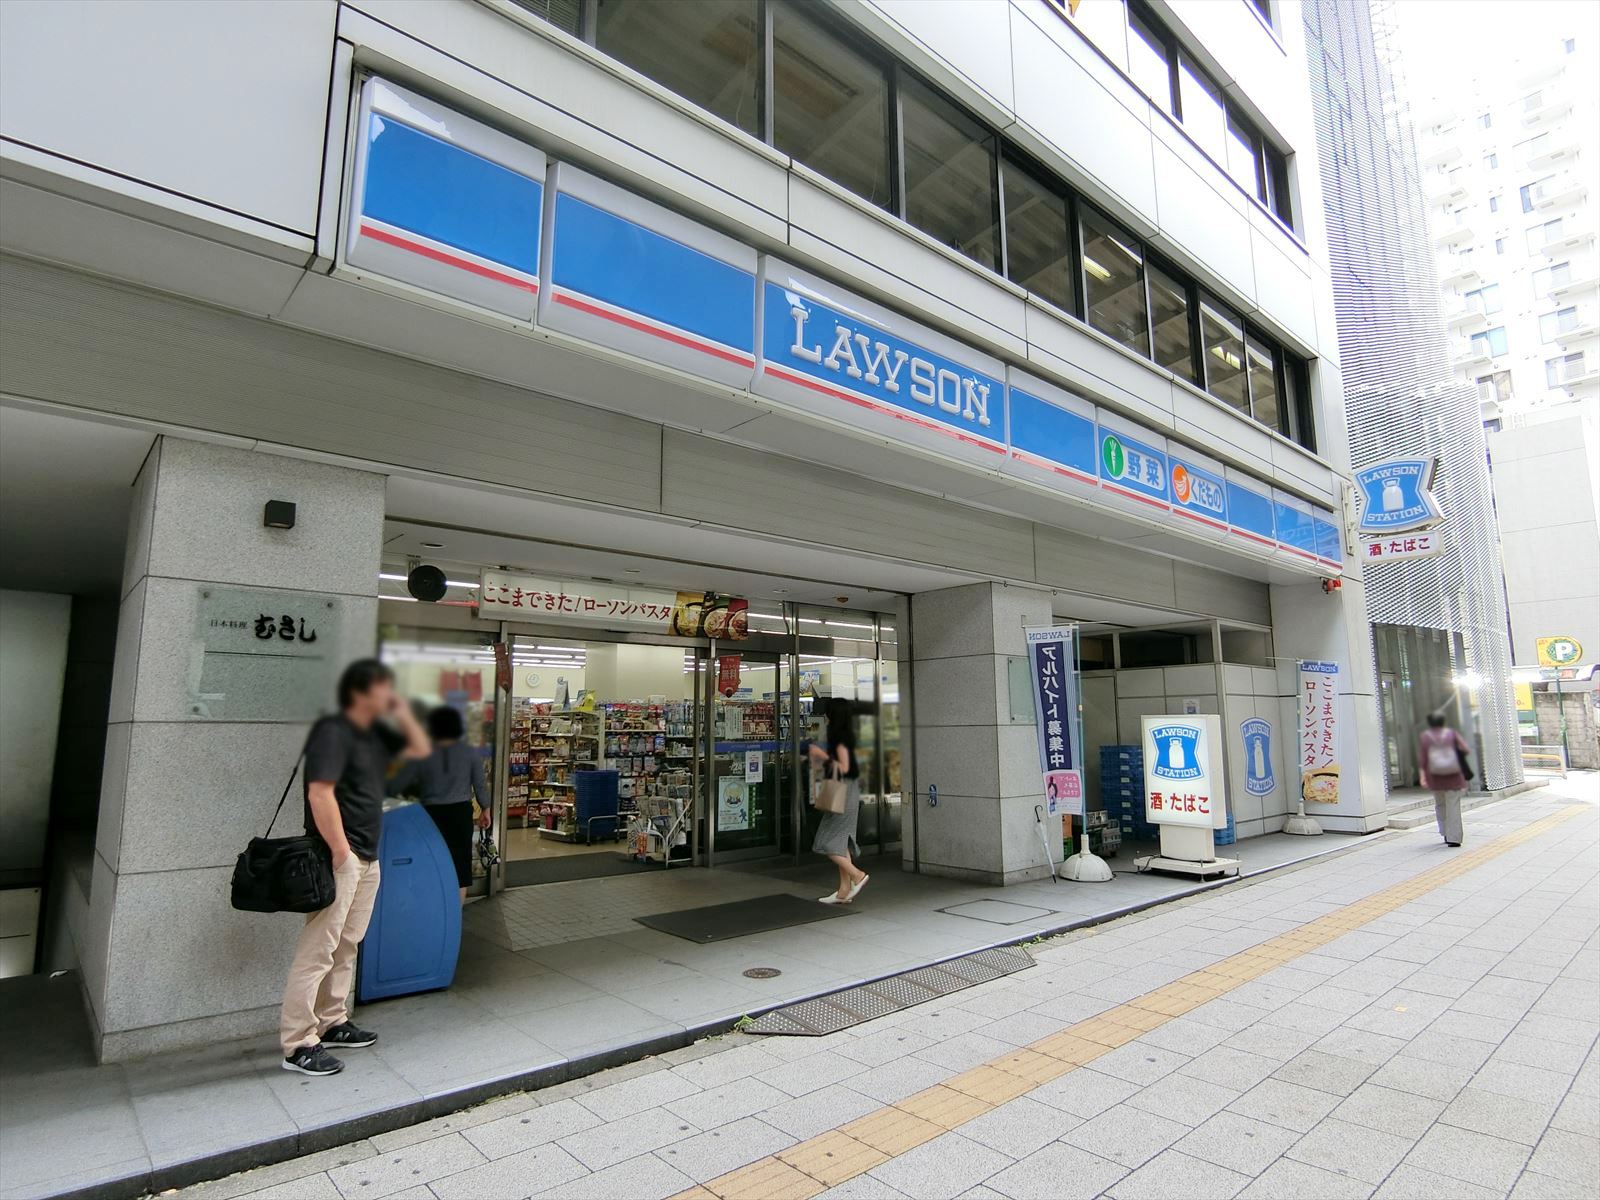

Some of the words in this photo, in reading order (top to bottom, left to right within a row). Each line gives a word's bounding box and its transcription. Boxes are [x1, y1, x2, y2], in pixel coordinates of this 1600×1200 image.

[790, 306, 991, 427] LAWSON
[1127, 449, 1160, 487] 野菜
[1362, 466, 1419, 484] LAWSON
[1190, 478, 1222, 511] くだもの
[1367, 505, 1425, 522] STATION
[1369, 538, 1430, 556] 酒・たばこ
[210, 619, 248, 630] 日本料理
[254, 613, 317, 642] むさし
[1554, 642, 1574, 661] P
[1302, 663, 1336, 673] LAWSON
[1243, 723, 1270, 738] LAWSON
[1303, 681, 1318, 767] ローソンパスタ
[1154, 728, 1197, 740] LAWSON
[1157, 767, 1199, 779] STATION
[1247, 777, 1275, 791] STATION
[1150, 792, 1210, 814] 酒・たばこ
